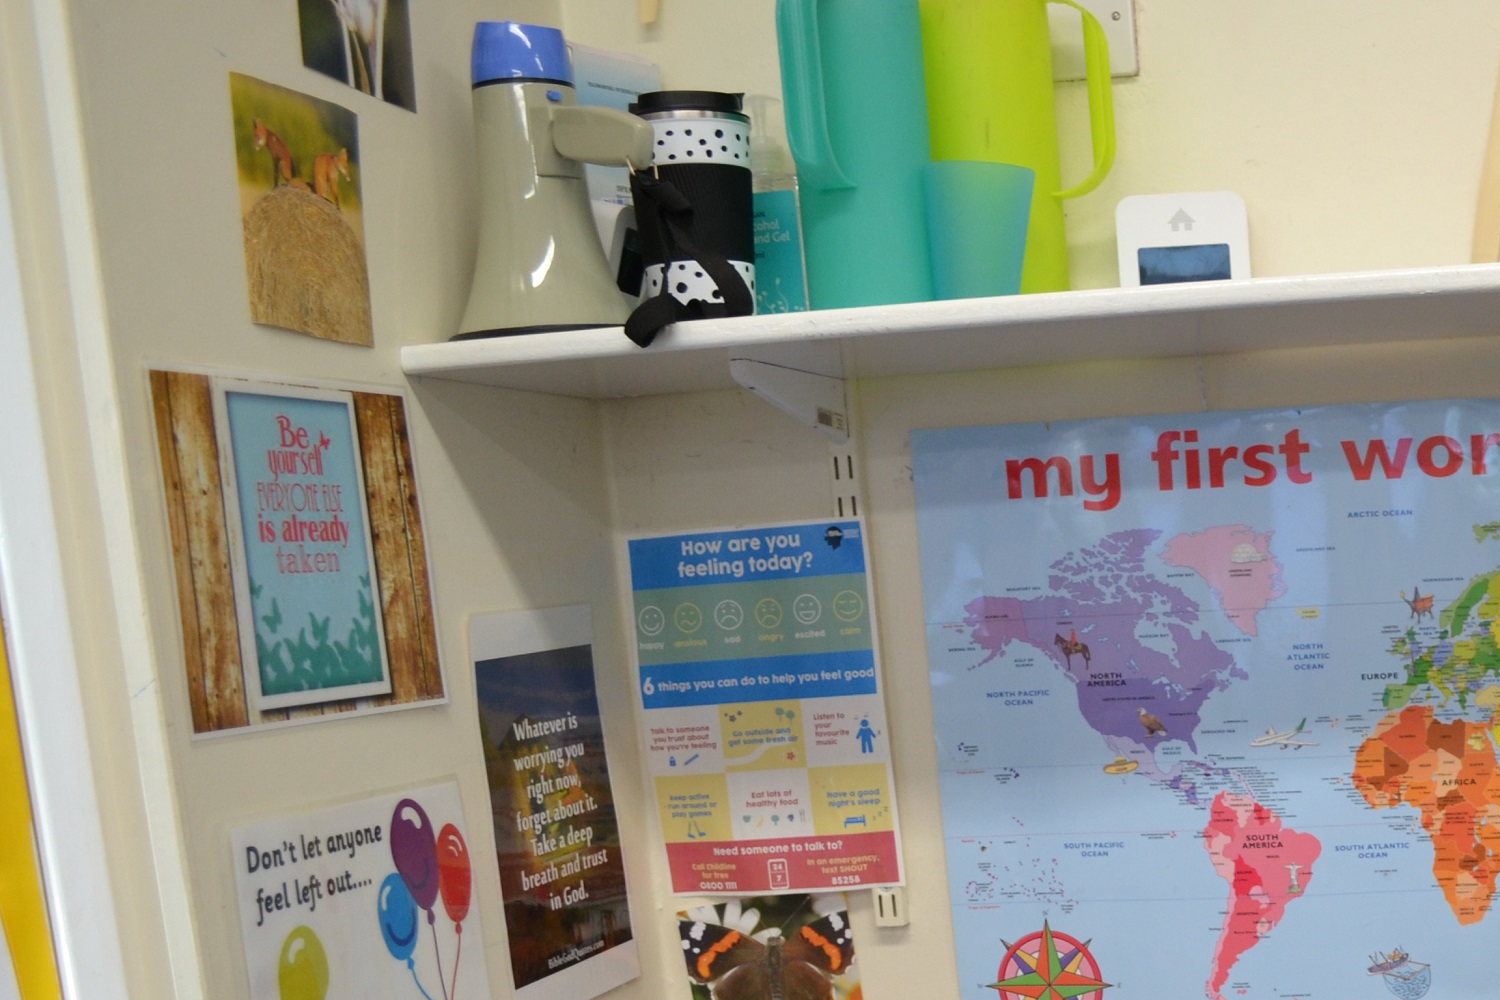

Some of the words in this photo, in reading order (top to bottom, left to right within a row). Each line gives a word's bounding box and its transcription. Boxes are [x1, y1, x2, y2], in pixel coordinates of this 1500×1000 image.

[754, 233, 771, 244] and
[772, 231, 791, 243] Gel
[276, 415, 310, 449] Be
[1005, 453, 1122, 512] my
[1151, 429, 1313, 492] first
[1347, 510, 1379, 519] ARCTIC
[1382, 508, 1414, 517] OCEAN
[258, 513, 276, 543] is
[282, 514, 350, 549] already
[681, 539, 722, 556] How
[728, 537, 760, 552] are
[765, 533, 801, 552] you
[276, 545, 341, 574] taken
[677, 557, 744, 578] feeling
[748, 551, 813, 574] today?
[1293, 643, 1323, 651] NORTH
[1286, 652, 1330, 661] ATLANTIC
[1294, 663, 1324, 671] OCEAN
[643, 677, 655, 696] 6
[658, 678, 691, 693] things
[693, 680, 715, 694] you
[717, 677, 738, 688] can
[741, 675, 756, 686] do
[758, 673, 770, 685] to
[772, 671, 796, 687] help
[797, 672, 819, 687] you
[821, 668, 842, 681] feel
[844, 667, 875, 683] good
[1090, 672, 1123, 680] NORTH
[1361, 672, 1398, 681] EUROPE
[1087, 679, 1127, 688] AMERICA
[986, 691, 1016, 699] NORTH
[1018, 689, 1050, 698] PACIFIC
[1004, 699, 1033, 707] OCEAN
[512, 716, 567, 741] Whatever
[567, 711, 578, 730] is
[514, 745, 565, 773] worrying
[565, 741, 585, 767] you
[526, 774, 555, 805] right
[556, 772, 582, 790] now,
[1442, 778, 1477, 787] AFRICA
[516, 809, 552, 835] forget
[553, 798, 586, 822] about
[586, 795, 598, 815] it.
[530, 835, 557, 857] Take
[558, 832, 566, 843] a
[567, 826, 593, 847] deep
[1246, 833, 1279, 842] SOUTH
[246, 840, 297, 874] Don't
[300, 834, 322, 859] let
[326, 824, 383, 859] anyone
[1064, 842, 1092, 850] SOUTH
[1094, 841, 1125, 849] PACIFIC
[1242, 841, 1283, 849] AMERICA
[1335, 844, 1364, 852] SOUTH
[1366, 842, 1410, 851] ATLANTIC
[1081, 850, 1109, 858] OCEAN
[1358, 851, 1388, 859] OCEAN
[521, 864, 560, 891] breath
[560, 852, 581, 877] and
[582, 848, 608, 870] trust
[256, 883, 289, 927] feel
[295, 875, 325, 912] left
[549, 892, 562, 911] in
[564, 880, 589, 908] God.
